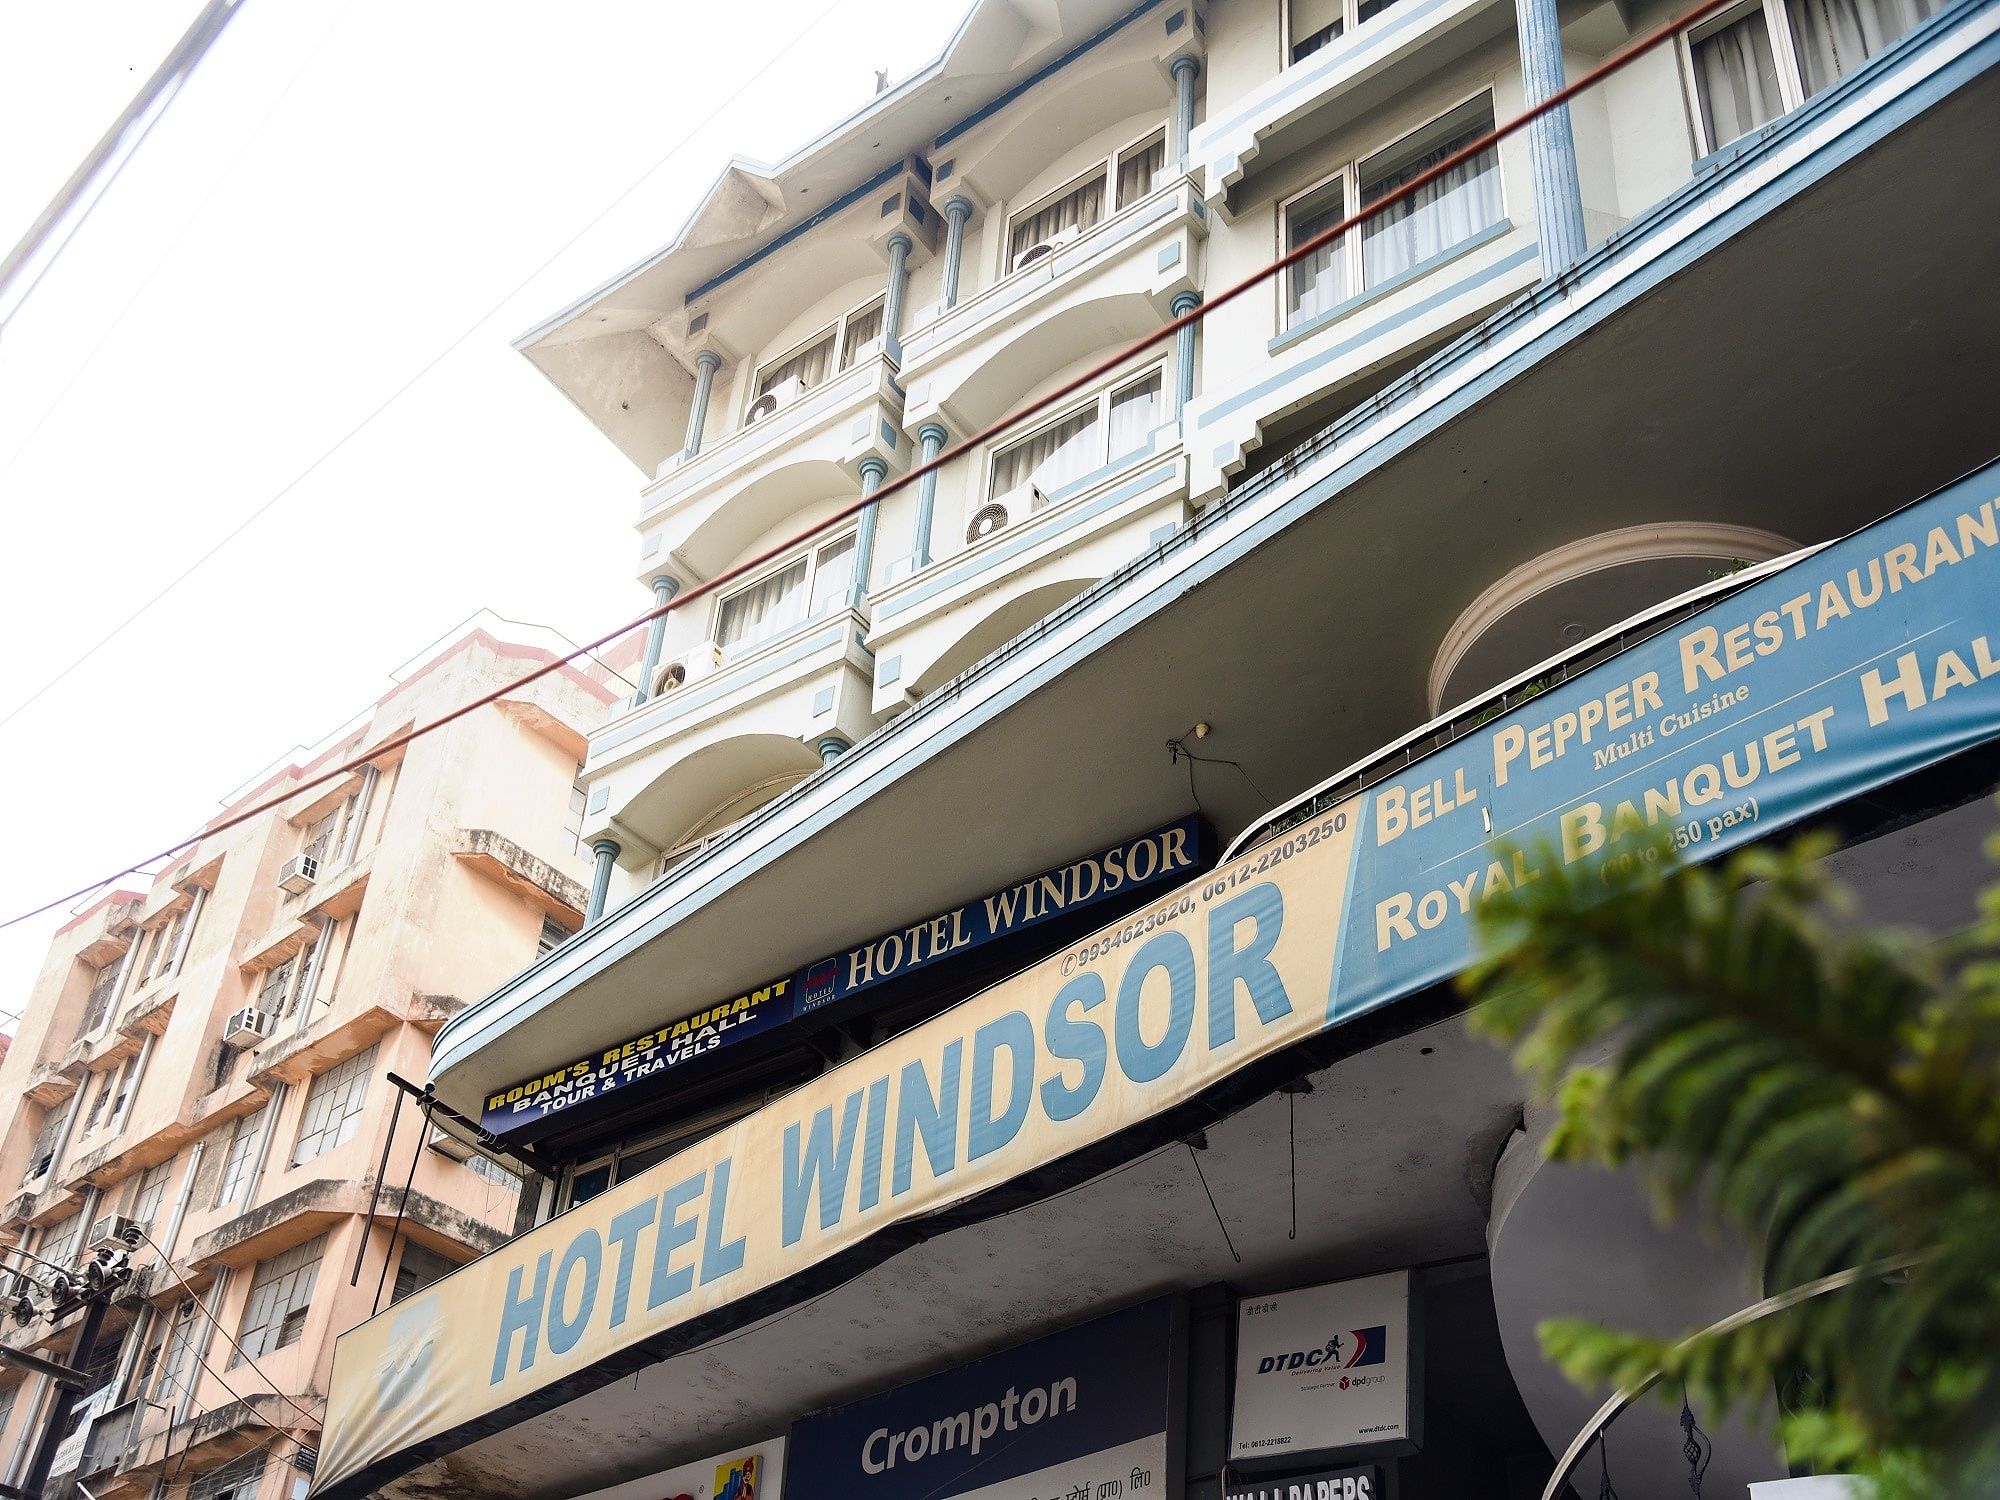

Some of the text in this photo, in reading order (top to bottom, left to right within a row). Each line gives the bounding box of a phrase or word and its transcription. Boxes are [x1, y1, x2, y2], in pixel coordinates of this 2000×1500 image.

[1376, 497, 2000, 847] BELL PEPPER RESTAURAN
[1593, 685, 1750, 770] Multi Cuisine
[1376, 850, 1540, 952] ROYAL
[1560, 706, 1835, 865] BANQUET
[1707, 797, 1759, 841] pax)
[846, 827, 1193, 991] HOTEL WINDSOR
[1078, 813, 1347, 967] 9934623620, 0612-2203250
[803, 994, 836, 1012] WINDSOR
[807, 987, 832, 1001] HOTEL
[488, 979, 791, 1111] ROOM'S RESTAURANT
[512, 1012, 757, 1114] BANQUET HALL
[540, 1035, 721, 1115] TOUR & TRAVELS
[490, 881, 1294, 1386] HOTEL WINDSOR
[1257, 1349, 1323, 1374] DTDC
[1291, 1364, 1341, 1376] Delivering Value
[861, 1376, 1077, 1475] Crompton
[1239, 1441, 1250, 1449] Tel:
[1359, 1424, 1399, 1434] www.dtdc.com
